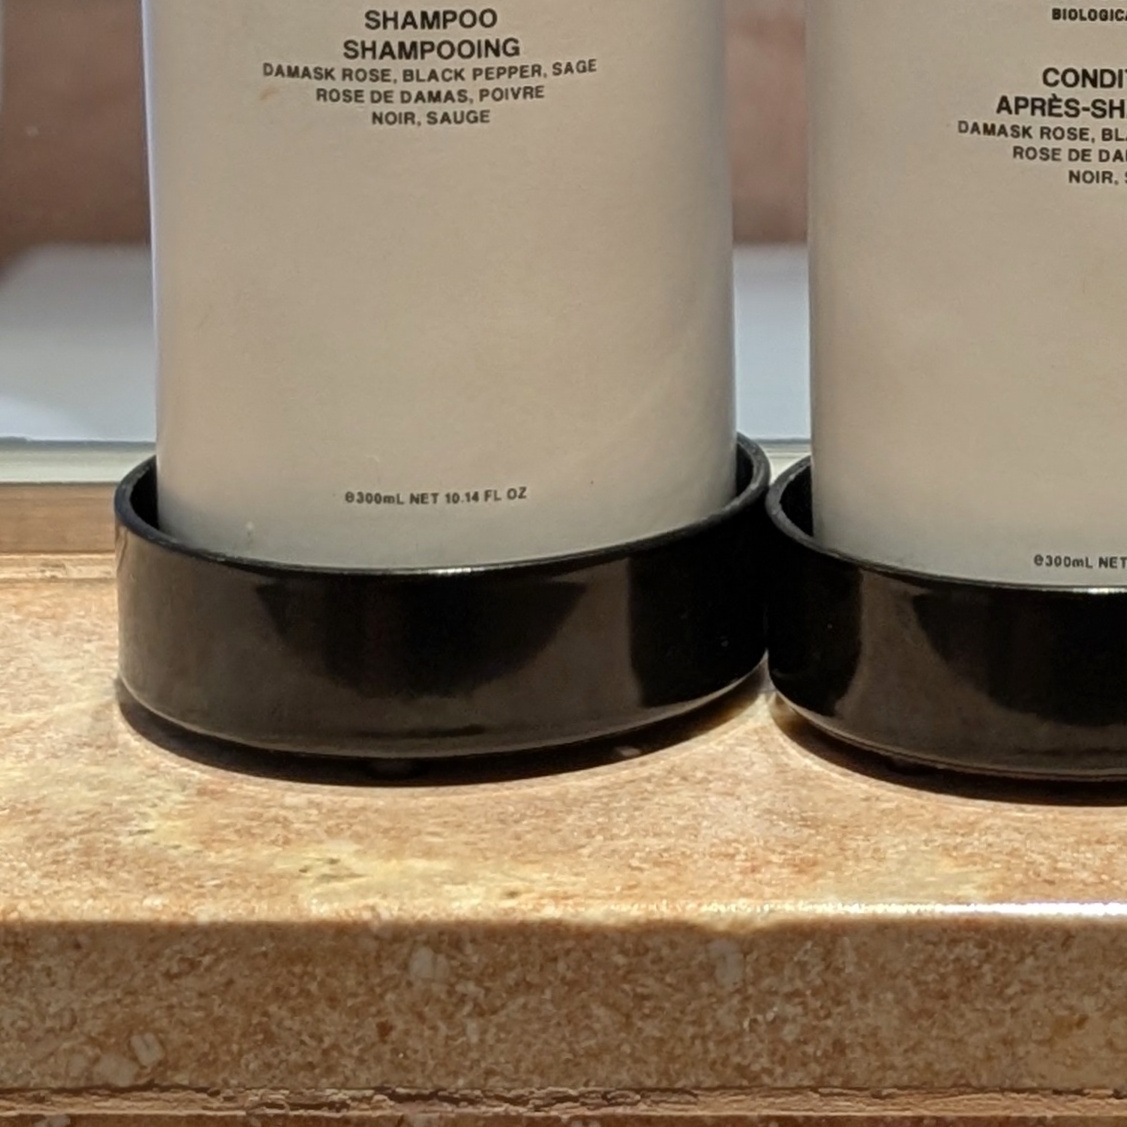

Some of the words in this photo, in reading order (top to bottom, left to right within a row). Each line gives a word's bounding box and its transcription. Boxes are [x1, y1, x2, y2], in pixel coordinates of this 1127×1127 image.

[365, 8, 498, 30] SHAMPOO
[343, 38, 521, 61] SHAMPOOING
[263, 63, 336, 81] DAMASK
[341, 67, 398, 84] ROSE,
[402, 67, 466, 82] BLACK
[472, 64, 547, 81] PEPPER,
[552, 59, 597, 76] SAGE
[316, 88, 365, 103] ROSE
[370, 89, 394, 103] DE
[400, 88, 474, 105] DAMAS,
[479, 85, 545, 101] POIVRE
[371, 111, 422, 127] NOIR,
[426, 110, 491, 125] SAUGE
[958, 120, 1033, 140] DAMASK
[1039, 126, 1096, 143] ROSE,
[1012, 146, 1062, 161] ROSE
[1067, 148, 1092, 162] DE
[1068, 169, 1120, 185] NOIR,
[409, 492, 439, 504] NET
[445, 491, 479, 504] 10.14
[484, 489, 501, 501] FL
[507, 487, 527, 500] OZ
[1098, 557, 1127, 569] NET
